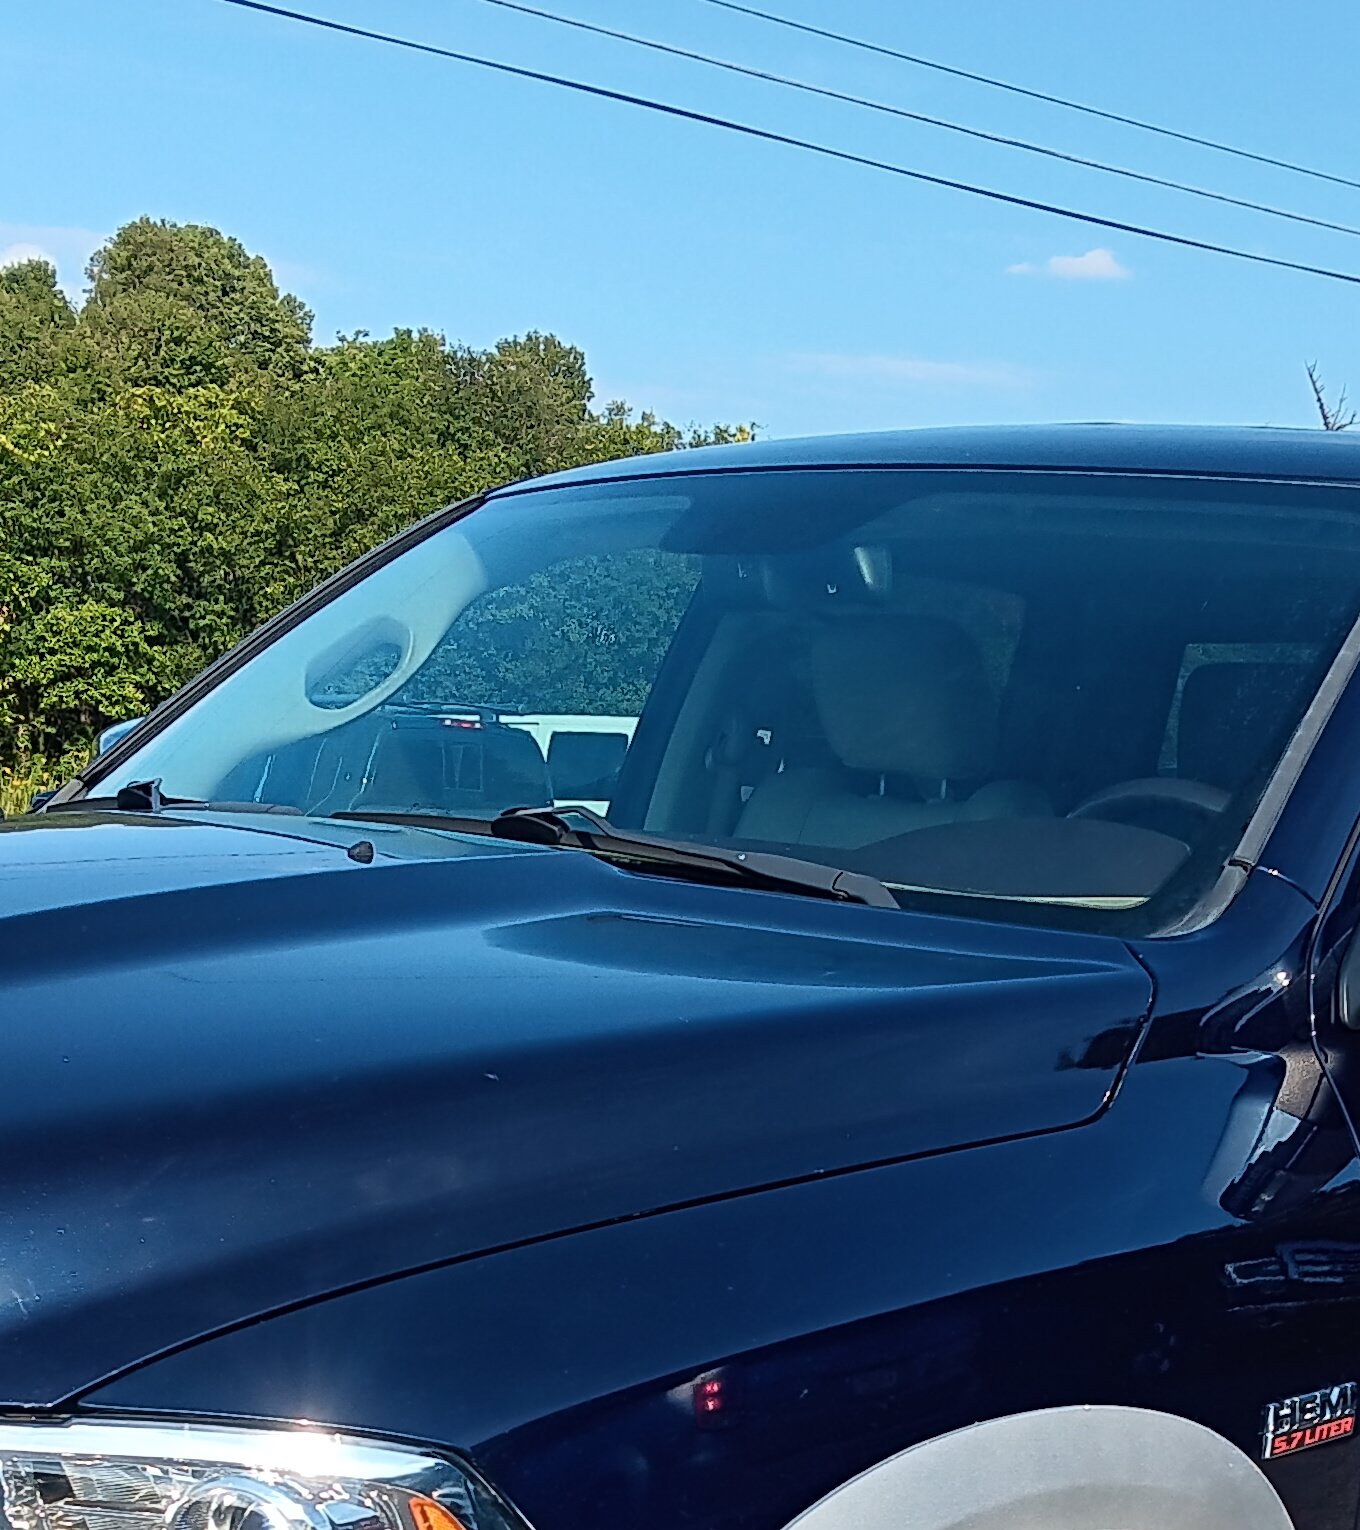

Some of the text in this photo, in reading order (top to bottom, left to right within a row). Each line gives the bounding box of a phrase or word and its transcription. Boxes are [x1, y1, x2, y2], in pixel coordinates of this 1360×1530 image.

[1262, 1381, 1358, 1436] HEMI
[1272, 1416, 1354, 1455] 5.7 LITER
